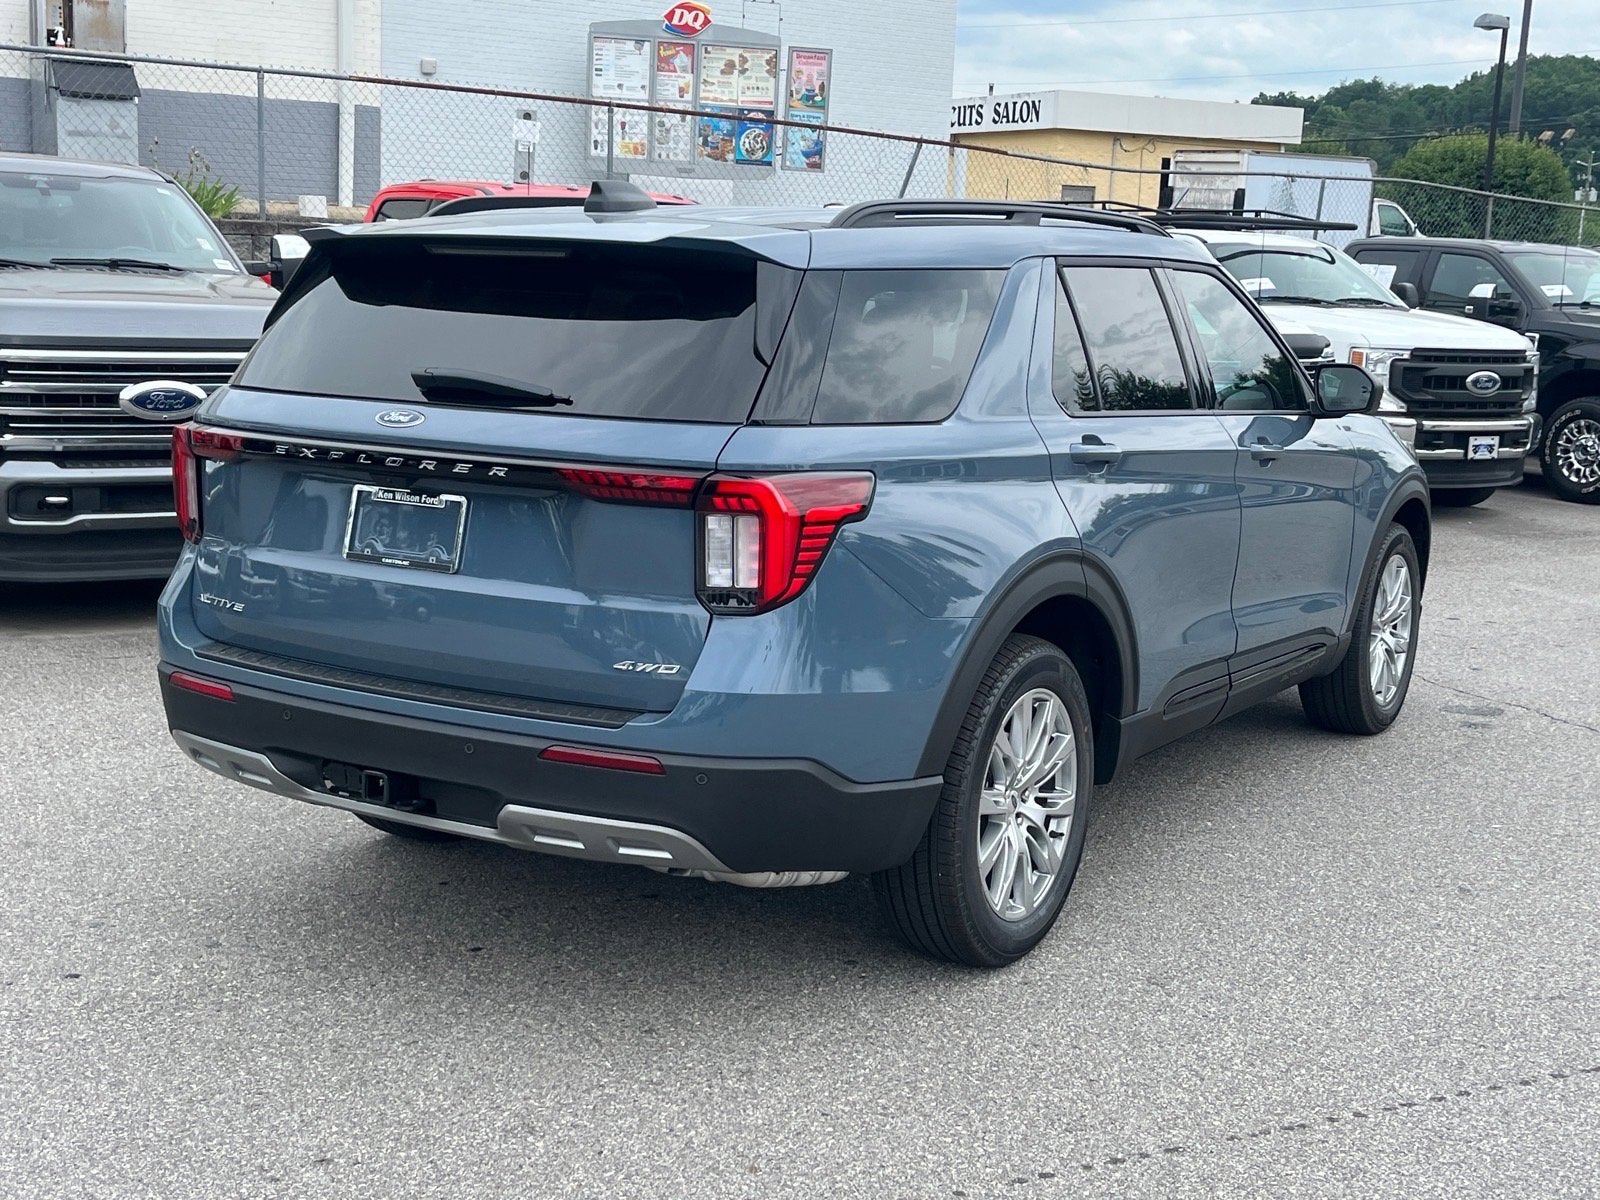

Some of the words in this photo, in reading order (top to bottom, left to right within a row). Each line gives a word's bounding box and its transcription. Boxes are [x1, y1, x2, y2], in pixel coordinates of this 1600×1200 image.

[671, 9, 703, 30] DQ
[992, 100, 1041, 124] SALON
[146, 392, 186, 408] Ford
[384, 411, 413, 422] Ford
[276, 444, 508, 477] EXPLORER
[377, 490, 393, 498] Ken
[394, 492, 420, 503] Wilson
[421, 495, 439, 504] Ford
[197, 593, 245, 611] ACTIVE
[613, 661, 680, 673] 4WD
